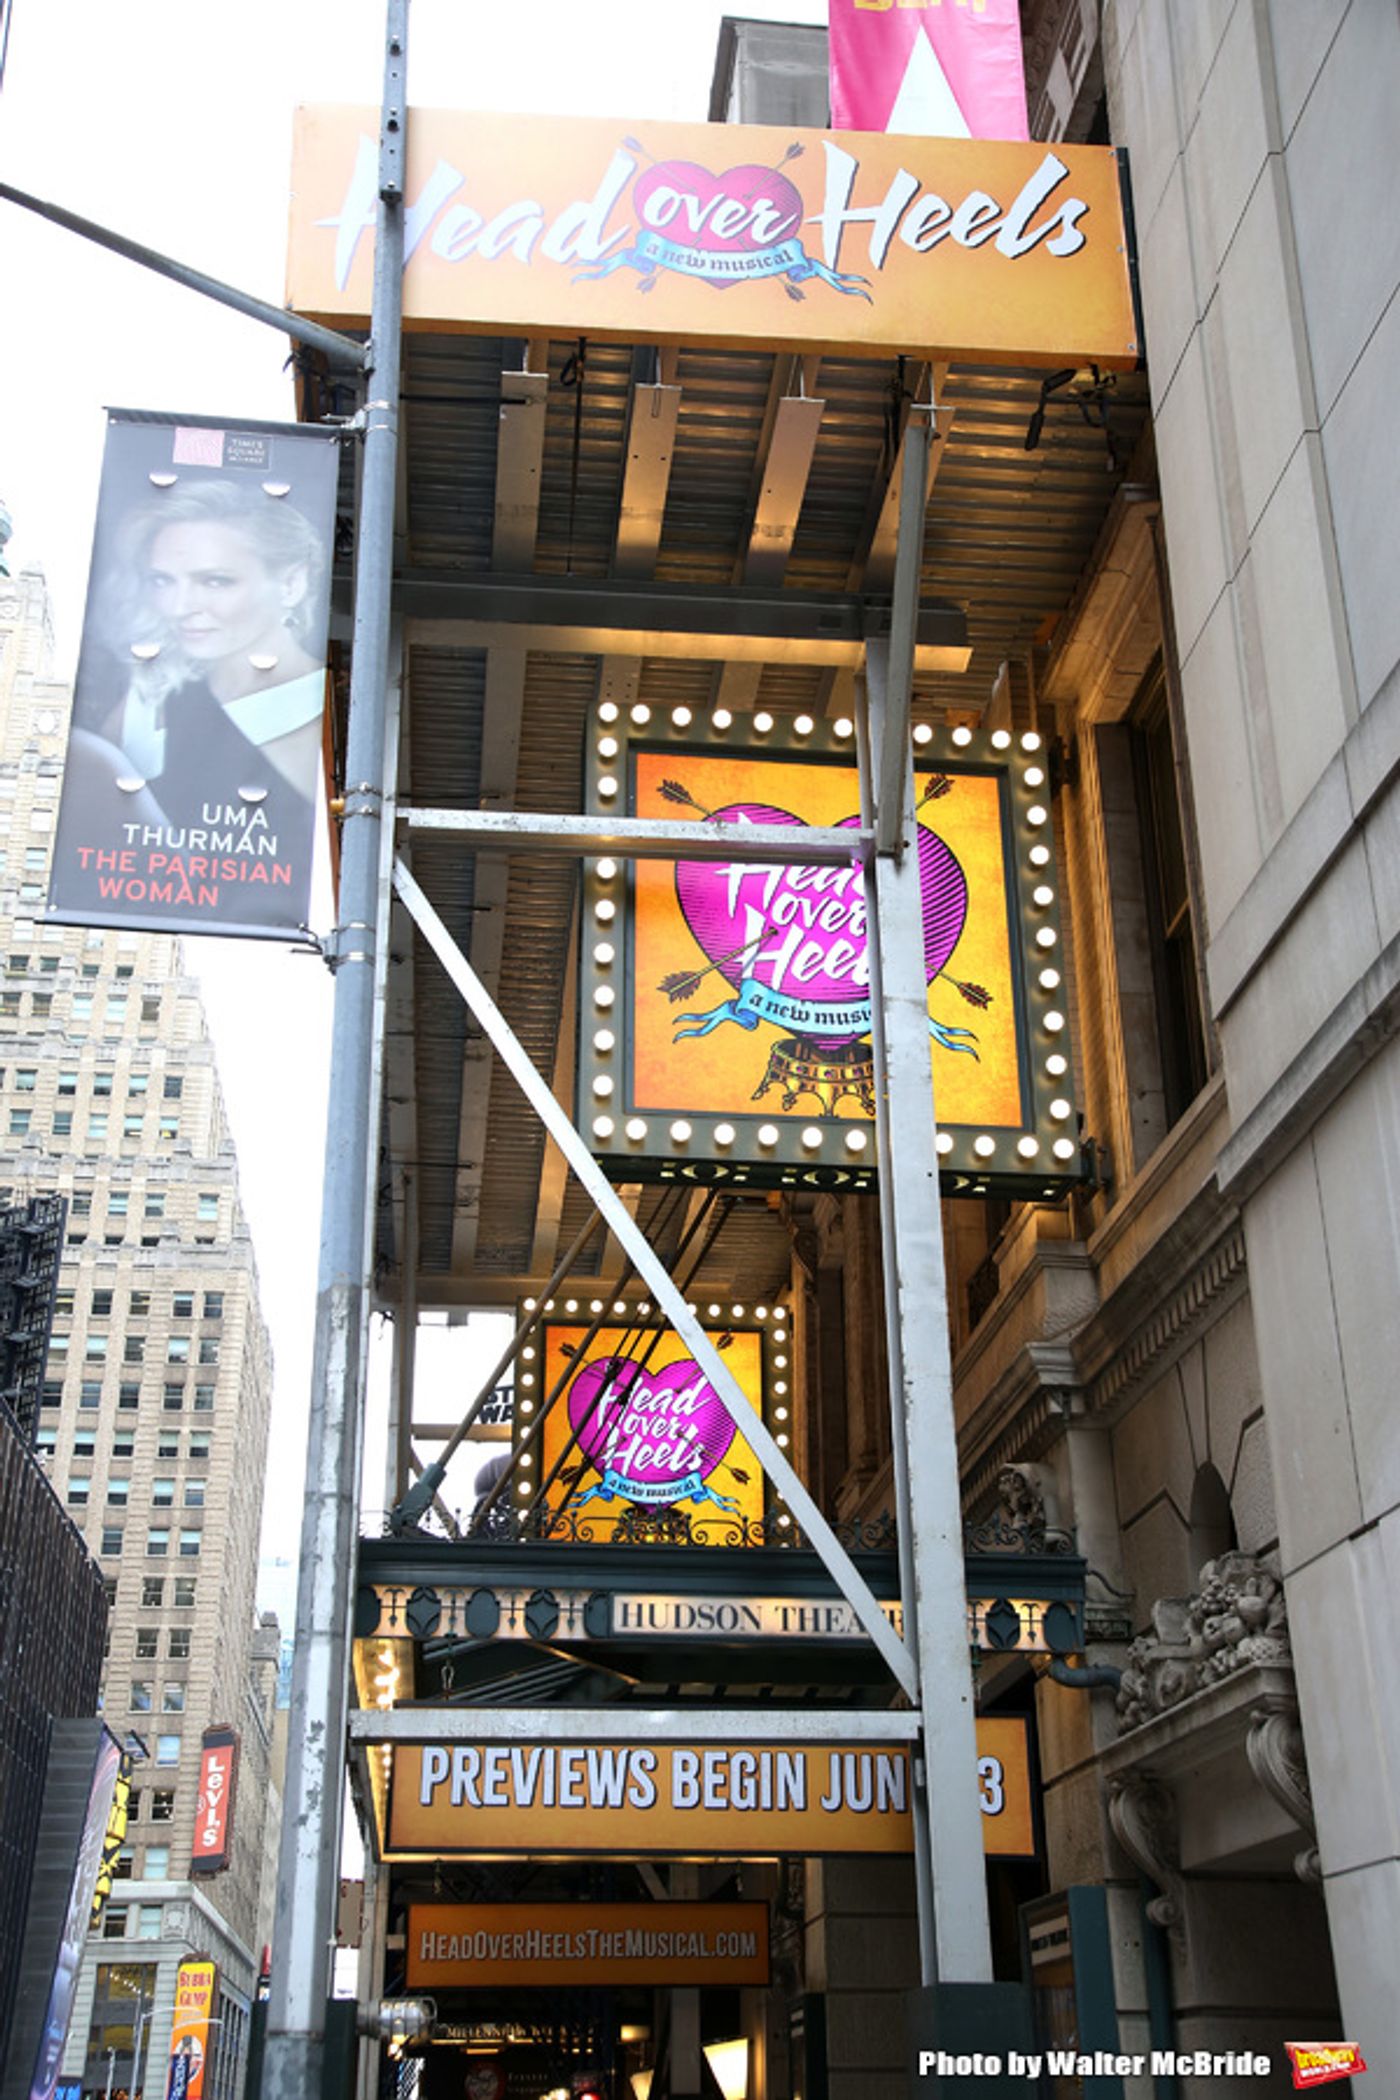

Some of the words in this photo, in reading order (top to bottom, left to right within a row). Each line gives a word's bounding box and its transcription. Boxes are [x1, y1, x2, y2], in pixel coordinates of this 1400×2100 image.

[314, 133, 638, 292] Head
[642, 184, 798, 245] over
[805, 140, 1090, 270] Heels
[646, 243, 660, 256] a
[661, 249, 706, 269] new
[709, 249, 795, 272] musical
[202, 802, 269, 829] UMA
[123, 823, 278, 856] THURMAN
[77, 847, 138, 873] THE
[149, 852, 292, 886] PARISIAN
[714, 811, 868, 919] Hea
[98, 876, 220, 907] WOMAN
[734, 902, 871, 992] Hee
[749, 993, 761, 1007] a
[765, 1000, 810, 1023] new
[597, 1374, 712, 1429] Head
[623, 1412, 690, 1441] over
[602, 1421, 705, 1478] Heels
[620, 1602, 764, 1632] HUDSON
[774, 1604, 904, 1634] THEA
[419, 1746, 658, 1809] PREVIEWS
[671, 1749, 808, 1812] BEGIN
[820, 1752, 914, 1814] JUN
